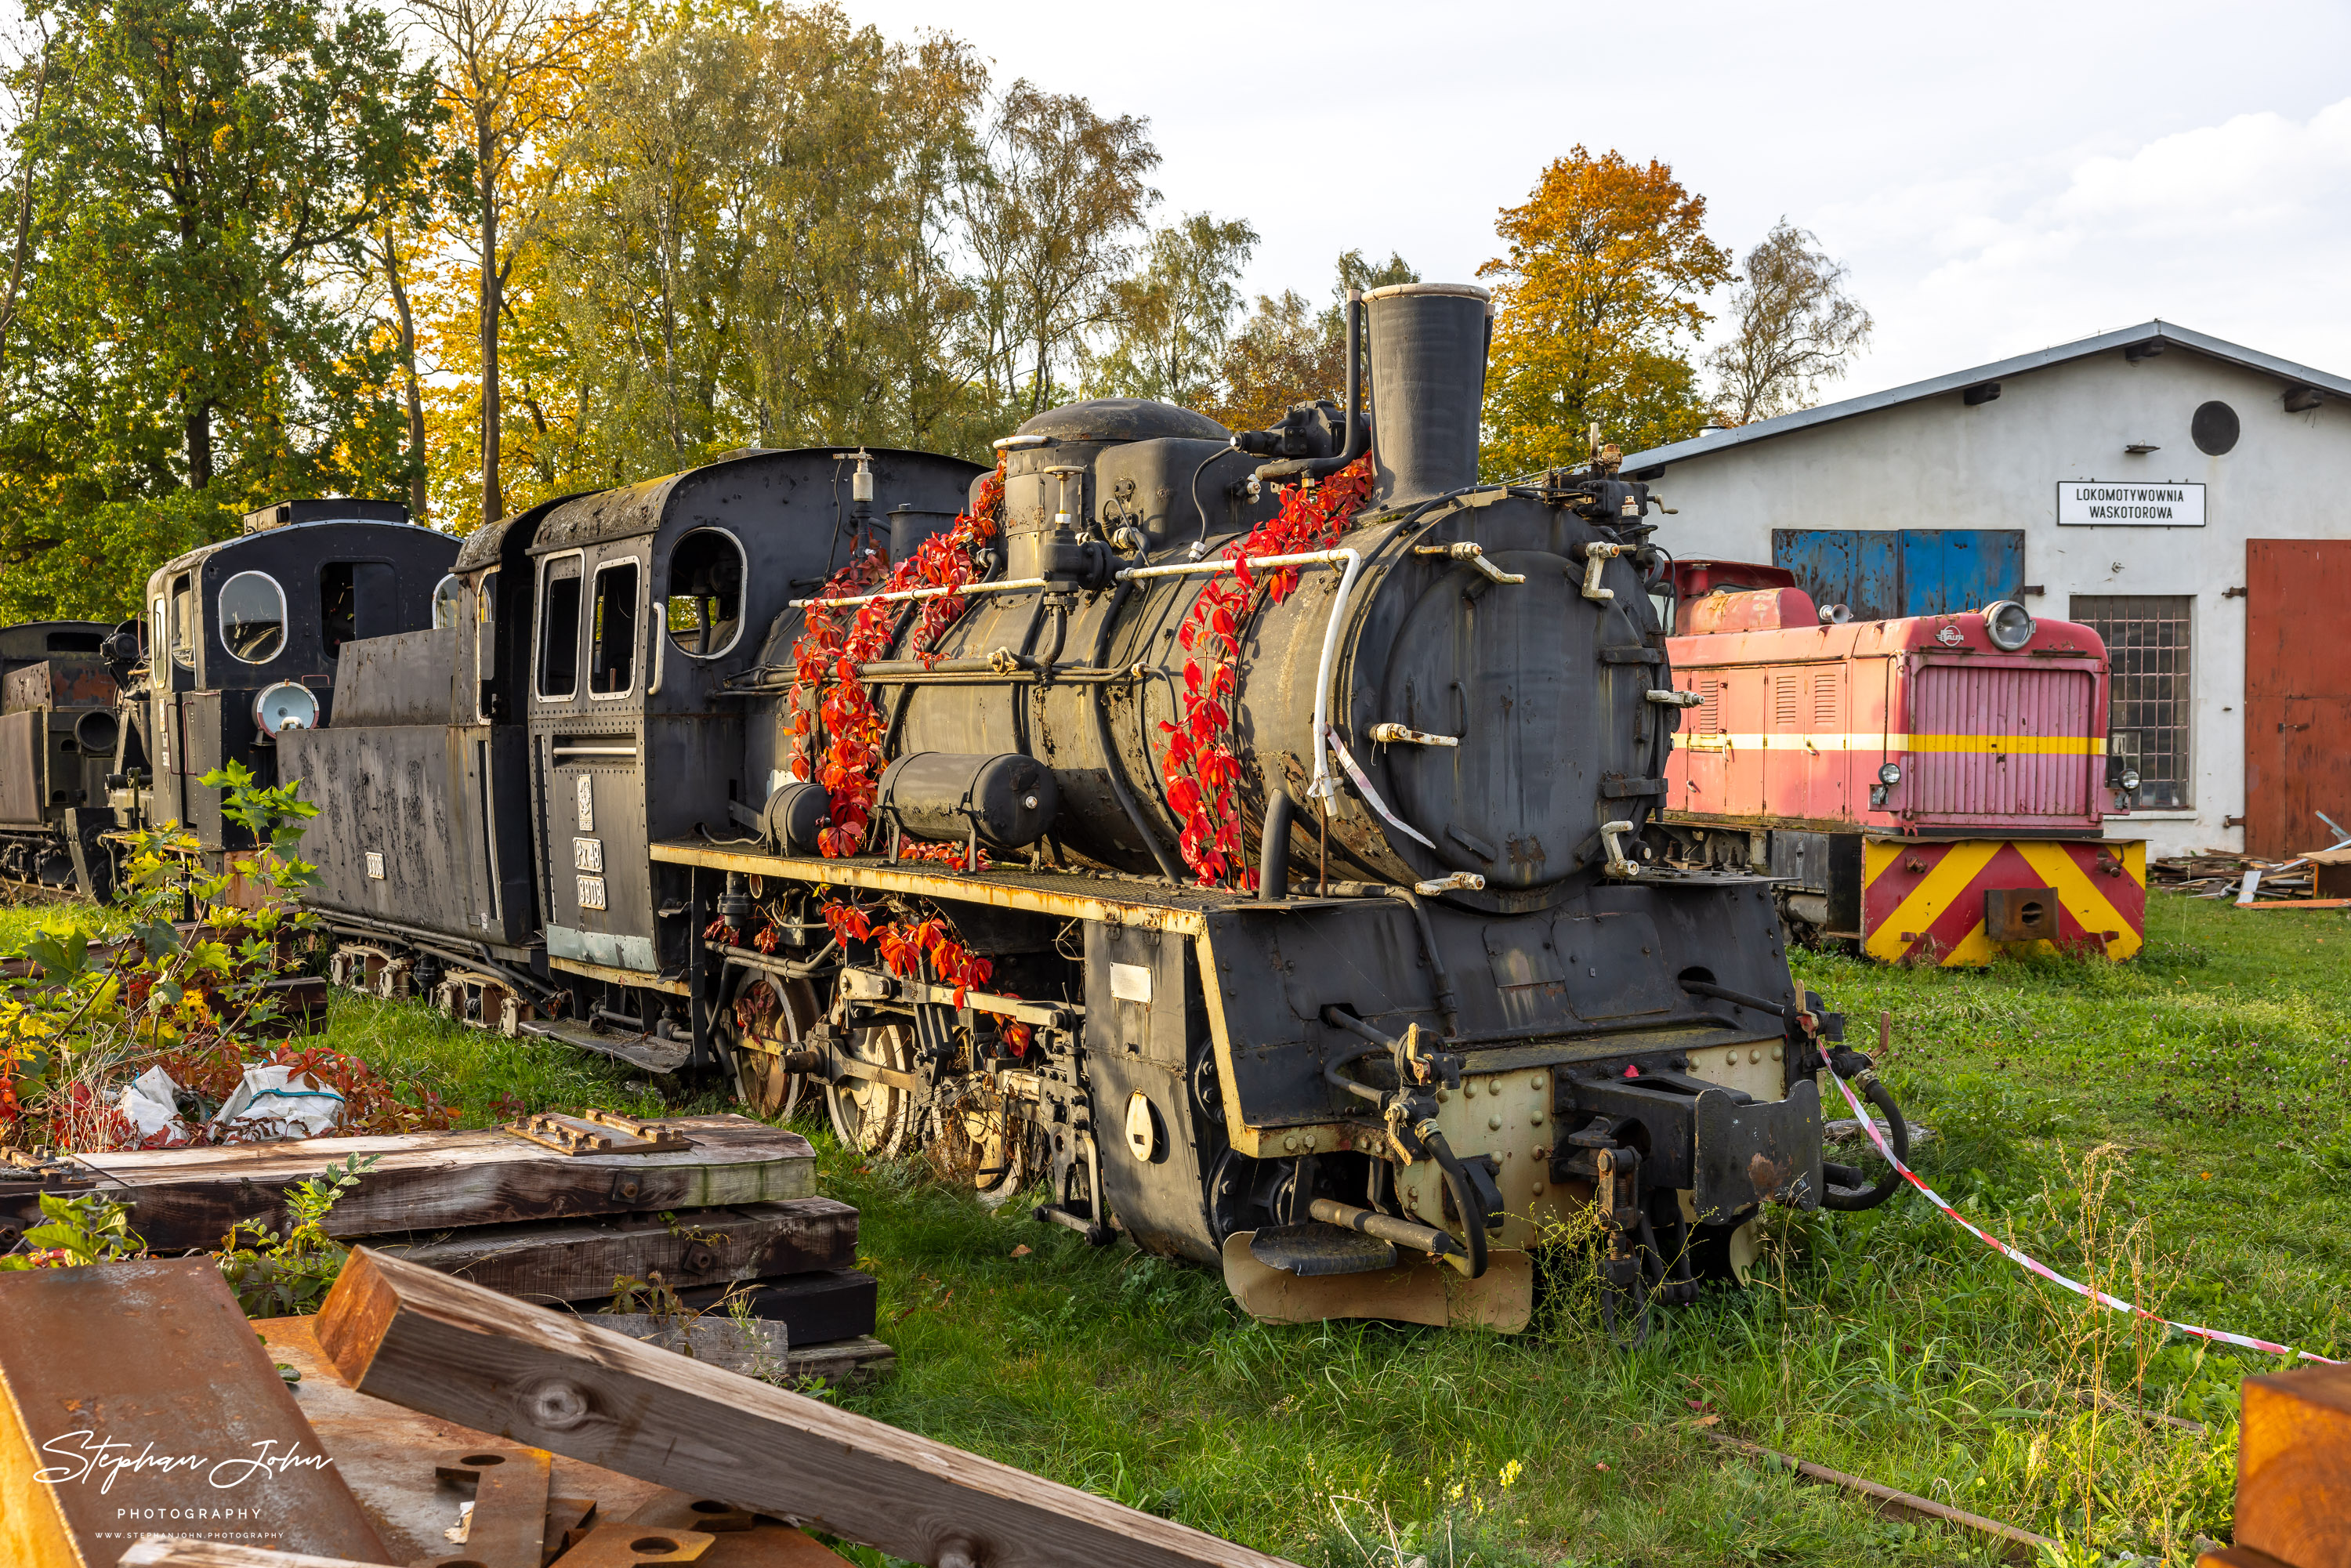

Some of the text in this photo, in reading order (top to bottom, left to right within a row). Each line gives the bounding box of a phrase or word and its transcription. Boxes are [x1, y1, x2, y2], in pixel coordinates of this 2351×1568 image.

[2076, 488, 2184, 502] LOKOMOTYWOWNIA
[580, 820, 592, 829] PKP
[576, 842, 600, 869] Px 48
